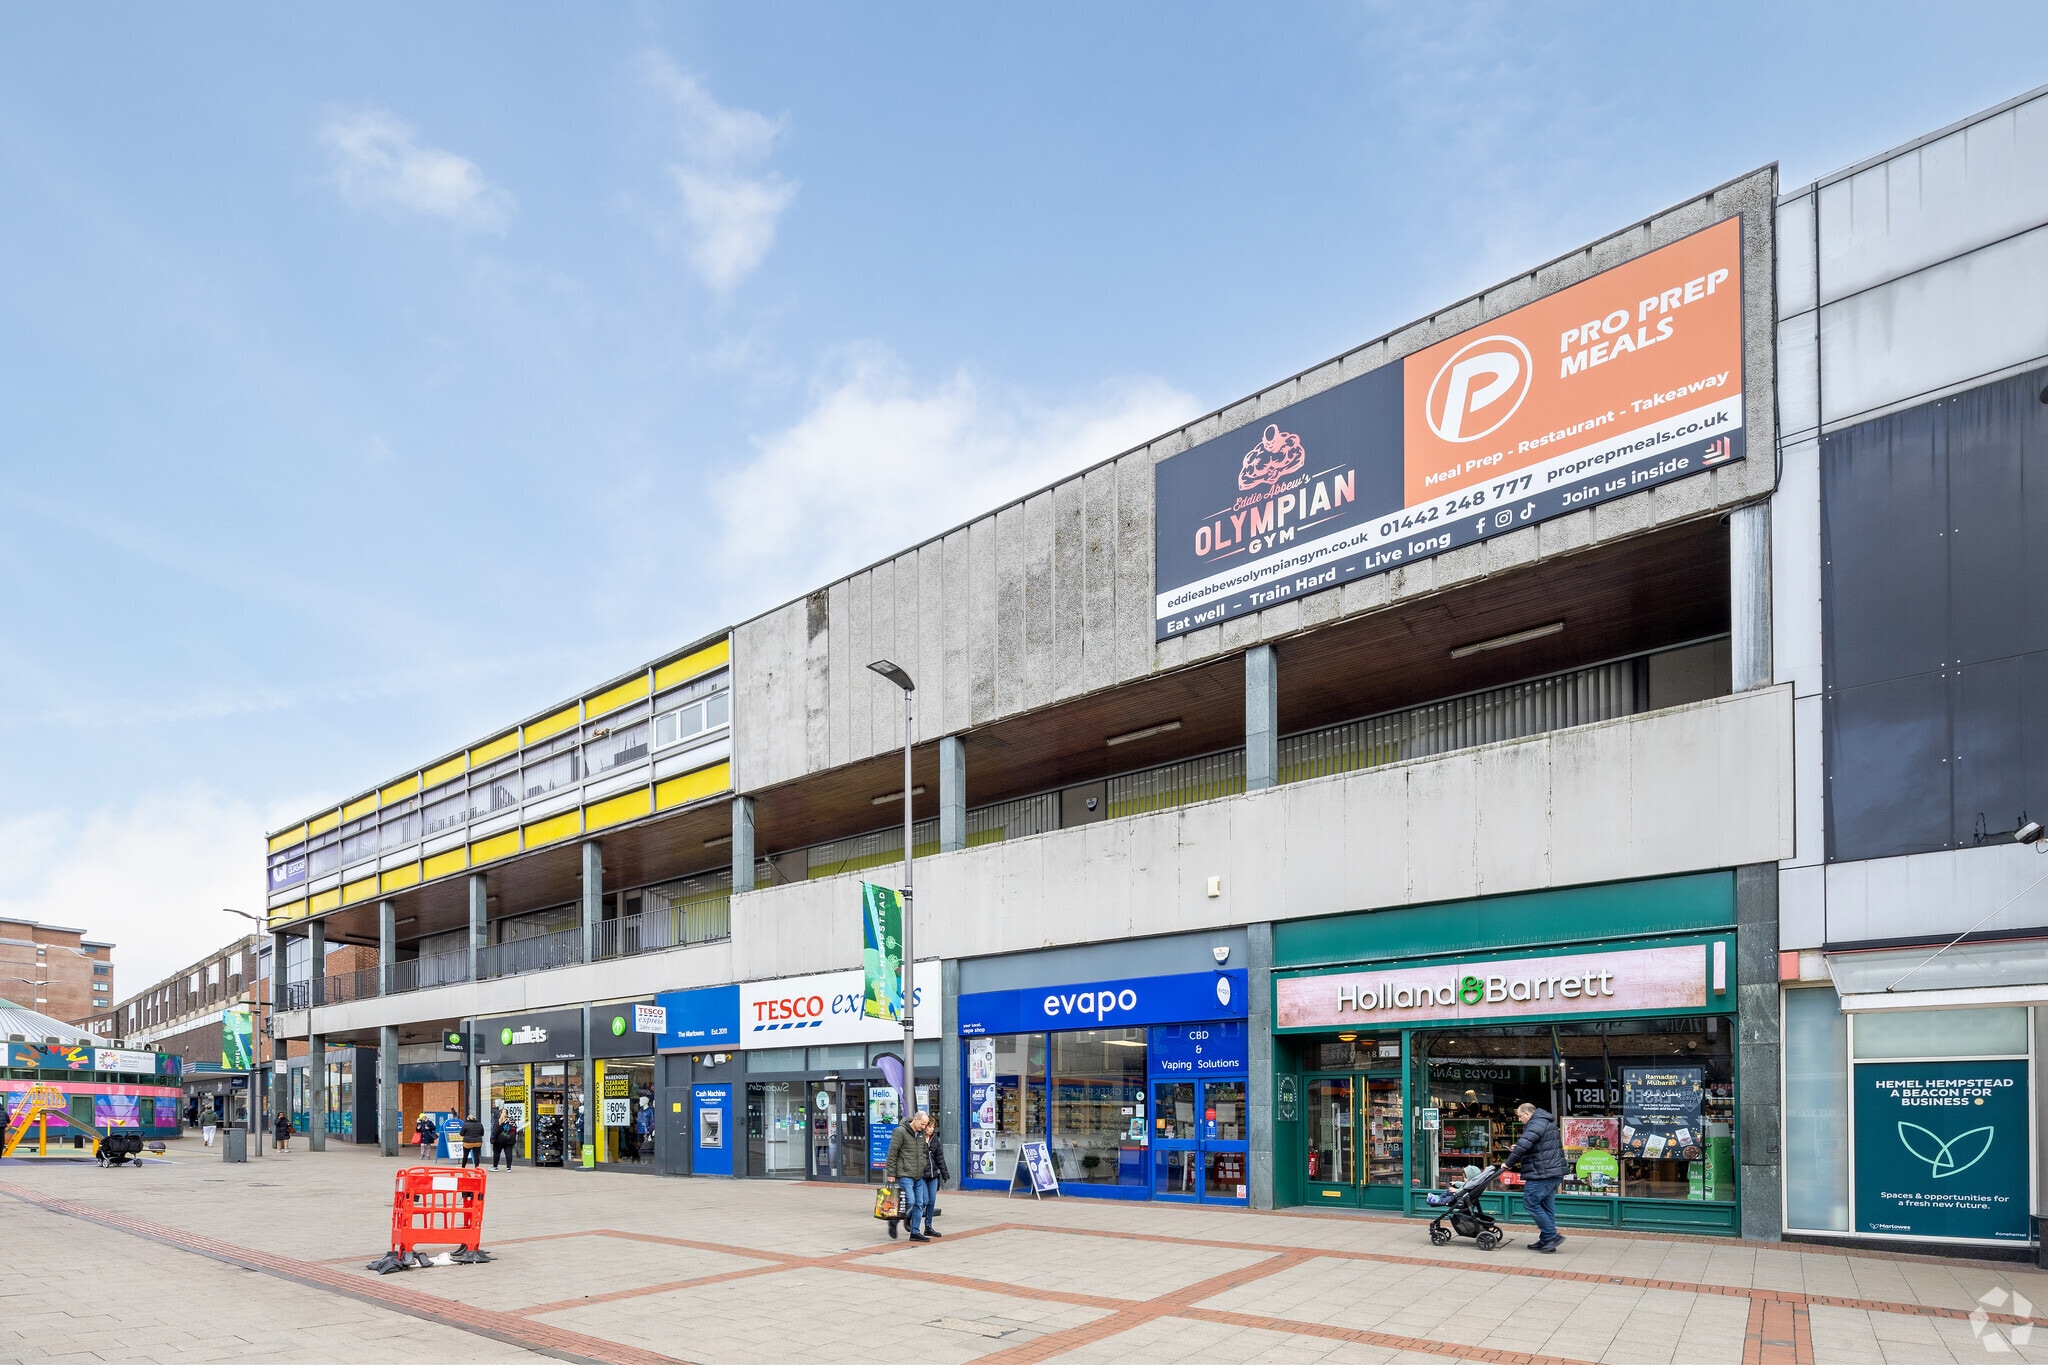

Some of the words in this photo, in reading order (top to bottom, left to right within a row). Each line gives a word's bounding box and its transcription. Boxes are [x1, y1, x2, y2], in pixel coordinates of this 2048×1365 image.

[1560, 309, 1630, 354] PRO
[1638, 268, 1729, 323] PREP
[1560, 316, 1674, 379] MEALS
[1425, 464, 1461, 487] Meal
[1465, 452, 1504, 473] Prep
[1518, 410, 1616, 454] Restaurant
[1631, 370, 1730, 414] Takeaway
[1547, 410, 1729, 483] proprepmeals.co.uk
[1562, 484, 1600, 506] Join
[1605, 476, 1627, 493] us
[1631, 455, 1690, 486] inside
[1232, 493, 1263, 512] Eddie
[1263, 472, 1312, 500] Abbew's
[1195, 469, 1356, 557] OLYMPIAN
[1380, 506, 1439, 537] 01442
[1445, 490, 1485, 516] 248
[1492, 474, 1533, 500] 777
[1249, 526, 1295, 554] GYM
[1167, 532, 1369, 608] eddieabbewsolympiangym.co.uk
[1167, 616, 1191, 634] Eat
[1194, 603, 1225, 625] well
[1250, 583, 1292, 607] Train
[1295, 566, 1337, 593] Hard
[1365, 546, 1403, 570] Live
[1408, 532, 1451, 556] long
[878, 891, 886, 967] HEMPSTEAD
[878, 973, 886, 1015] HEMEL
[639, 1007, 664, 1016] TESCO
[753, 995, 824, 1022] TESCO
[1043, 989, 1137, 1022] evapo
[638, 1017, 664, 1025] express
[512, 1025, 547, 1045] millets
[1189, 1031, 1210, 1040] CBD
[1195, 1045, 1203, 1054] &
[1330, 1051, 1362, 1059] SINCE
[1161, 1060, 1192, 1070] Vaping
[1197, 1058, 1239, 1069] Solutions
[1875, 1080, 1924, 1089] HEMEL
[1926, 1078, 2014, 1088] HEMPSTEAD
[1890, 1089, 1900, 1098] A
[1902, 1088, 1959, 1097] BEACON
[1962, 1088, 1992, 1097] FOR
[872, 1090, 891, 1098] Hello.
[1901, 1097, 1970, 1106] BUSINESS
[509, 1106, 523, 1115] 60%
[610, 1102, 627, 1113] 60%
[610, 1112, 625, 1123] OFF
[1880, 1191, 1913, 1200] Spaces
[1915, 1192, 1923, 1200] &
[1924, 1191, 1992, 1203] opportunities
[1993, 1194, 2010, 1203] for
[1905, 1199, 1931, 1207] fresh
[1955, 1201, 1991, 1210] future.
